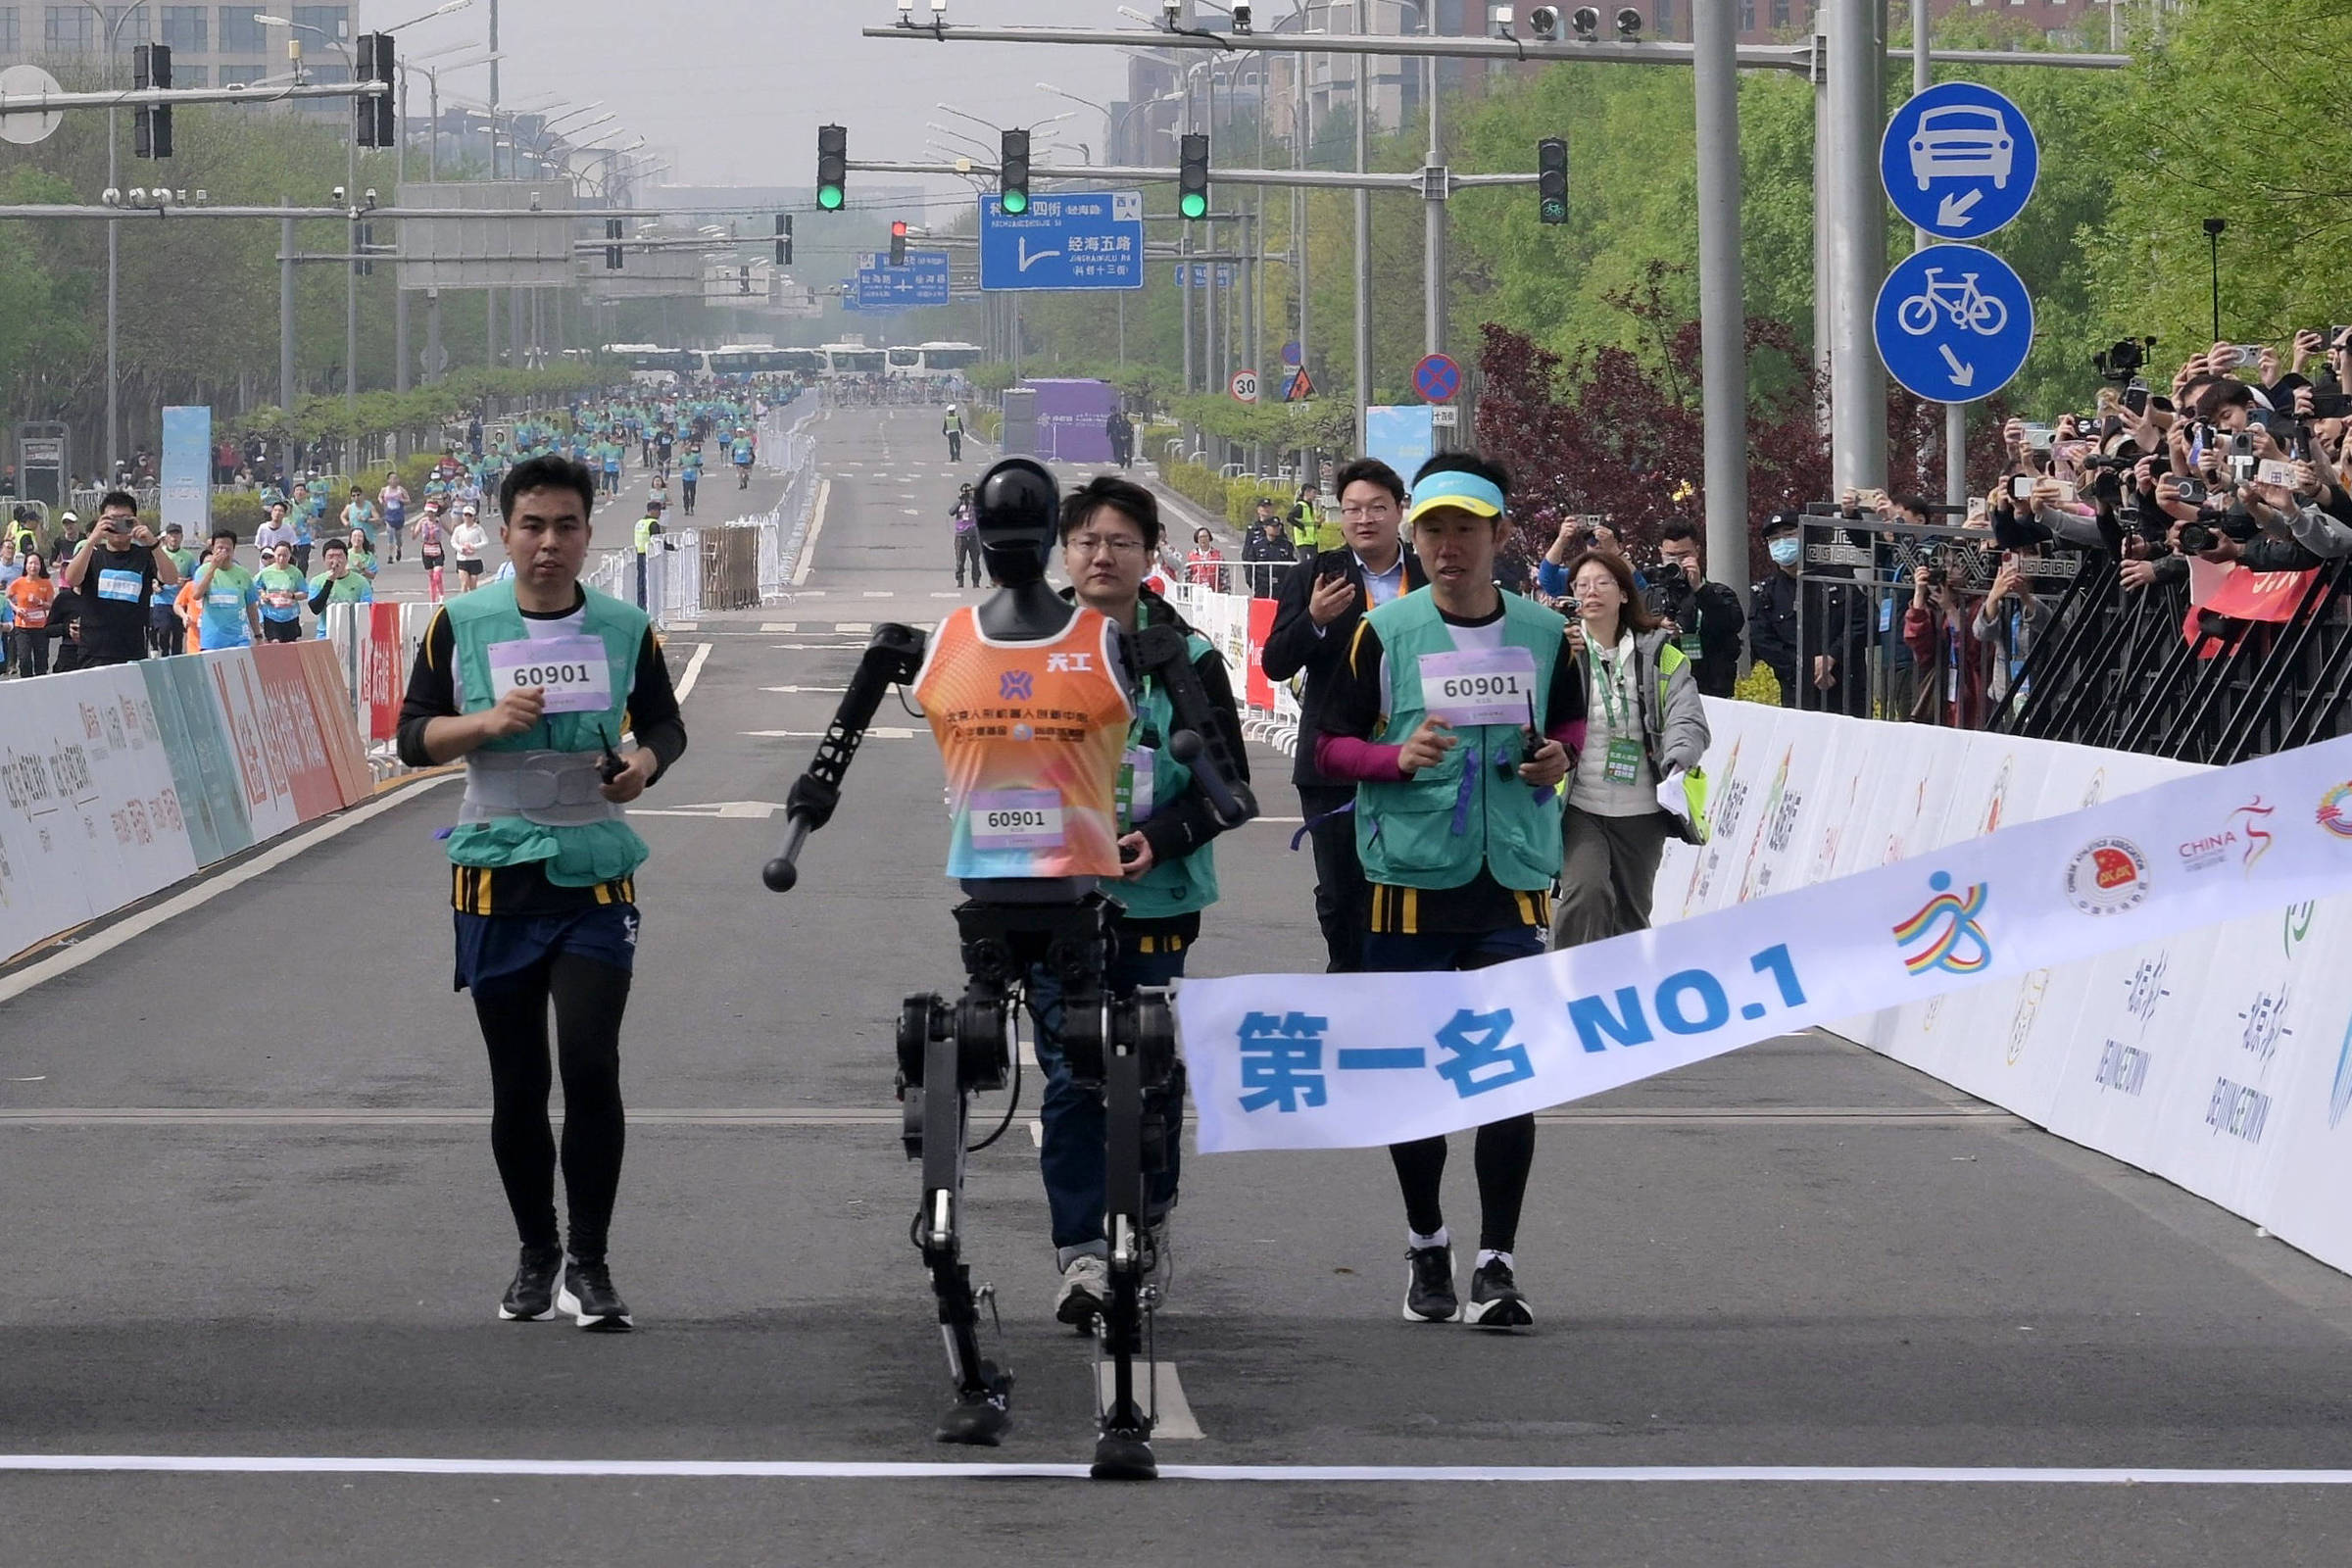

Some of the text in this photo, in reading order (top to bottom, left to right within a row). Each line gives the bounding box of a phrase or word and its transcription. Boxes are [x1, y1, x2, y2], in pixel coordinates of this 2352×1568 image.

[1068, 236, 1131, 252] 经海五路
[1236, 379, 1255, 394] 30
[1047, 653, 1092, 672] 天工
[514, 664, 590, 686] 60901
[1444, 676, 1519, 698] 60901
[988, 811, 1045, 827] 60901
[2179, 831, 2236, 858] CHINA
[1567, 943, 1807, 1053] NO.1
[1236, 1008, 1536, 1113] 第一名
